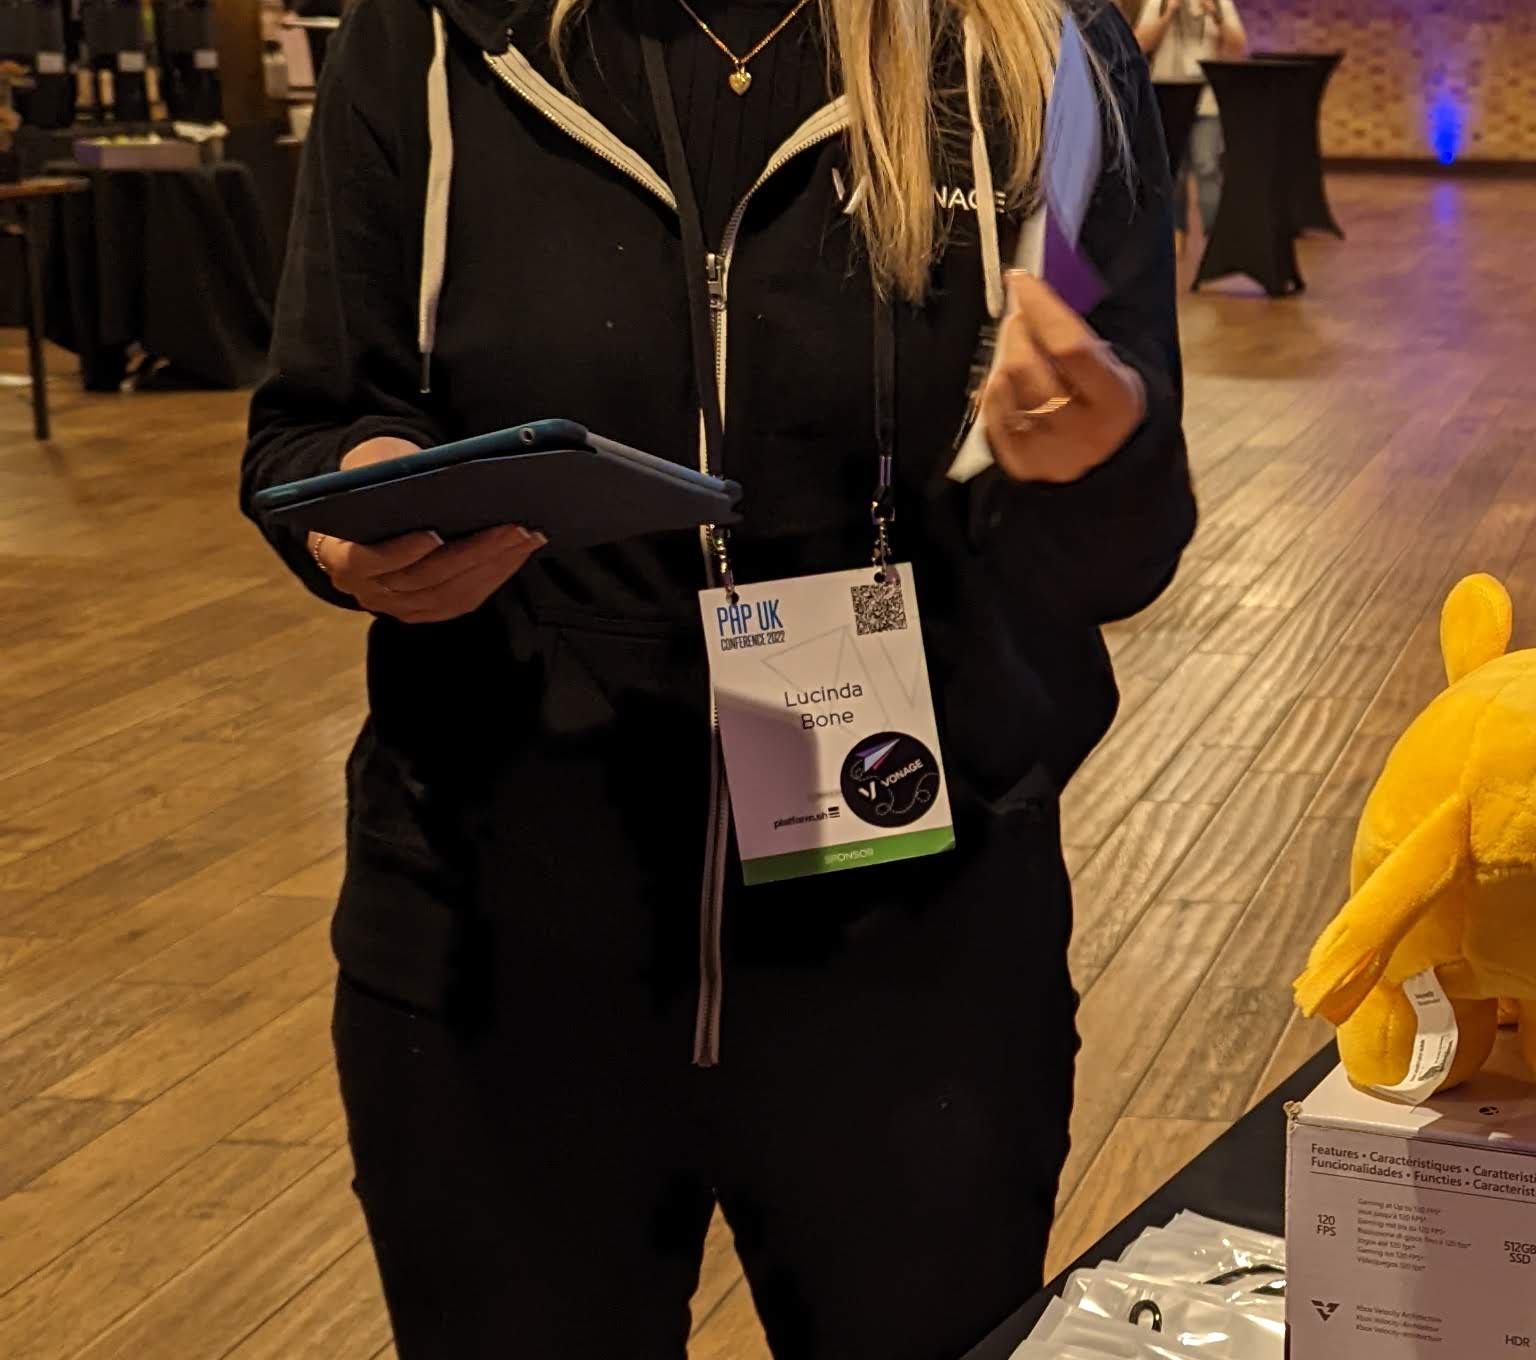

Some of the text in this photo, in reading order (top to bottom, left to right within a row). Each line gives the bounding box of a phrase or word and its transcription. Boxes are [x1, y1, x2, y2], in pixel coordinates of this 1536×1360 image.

[758, 599, 783, 631] UK
[721, 631, 785, 651] CONFERENCE 2022
[785, 681, 863, 707] Lucinda
[801, 710, 854, 729] Bone
[880, 758, 924, 788] VONAGE
[1311, 1143, 1359, 1159] Features
[1369, 1150, 1463, 1175] Caractéristiques
[1310, 1155, 1403, 1179] Funcionalidades
[1413, 1170, 1462, 1187] Functies
[1317, 1214, 1335, 1225] 120
[1316, 1224, 1336, 1237] FPS
[1503, 1240, 1536, 1255] 512GB
[1508, 1252, 1531, 1265] SSD
[1504, 1334, 1530, 1348] HDR
